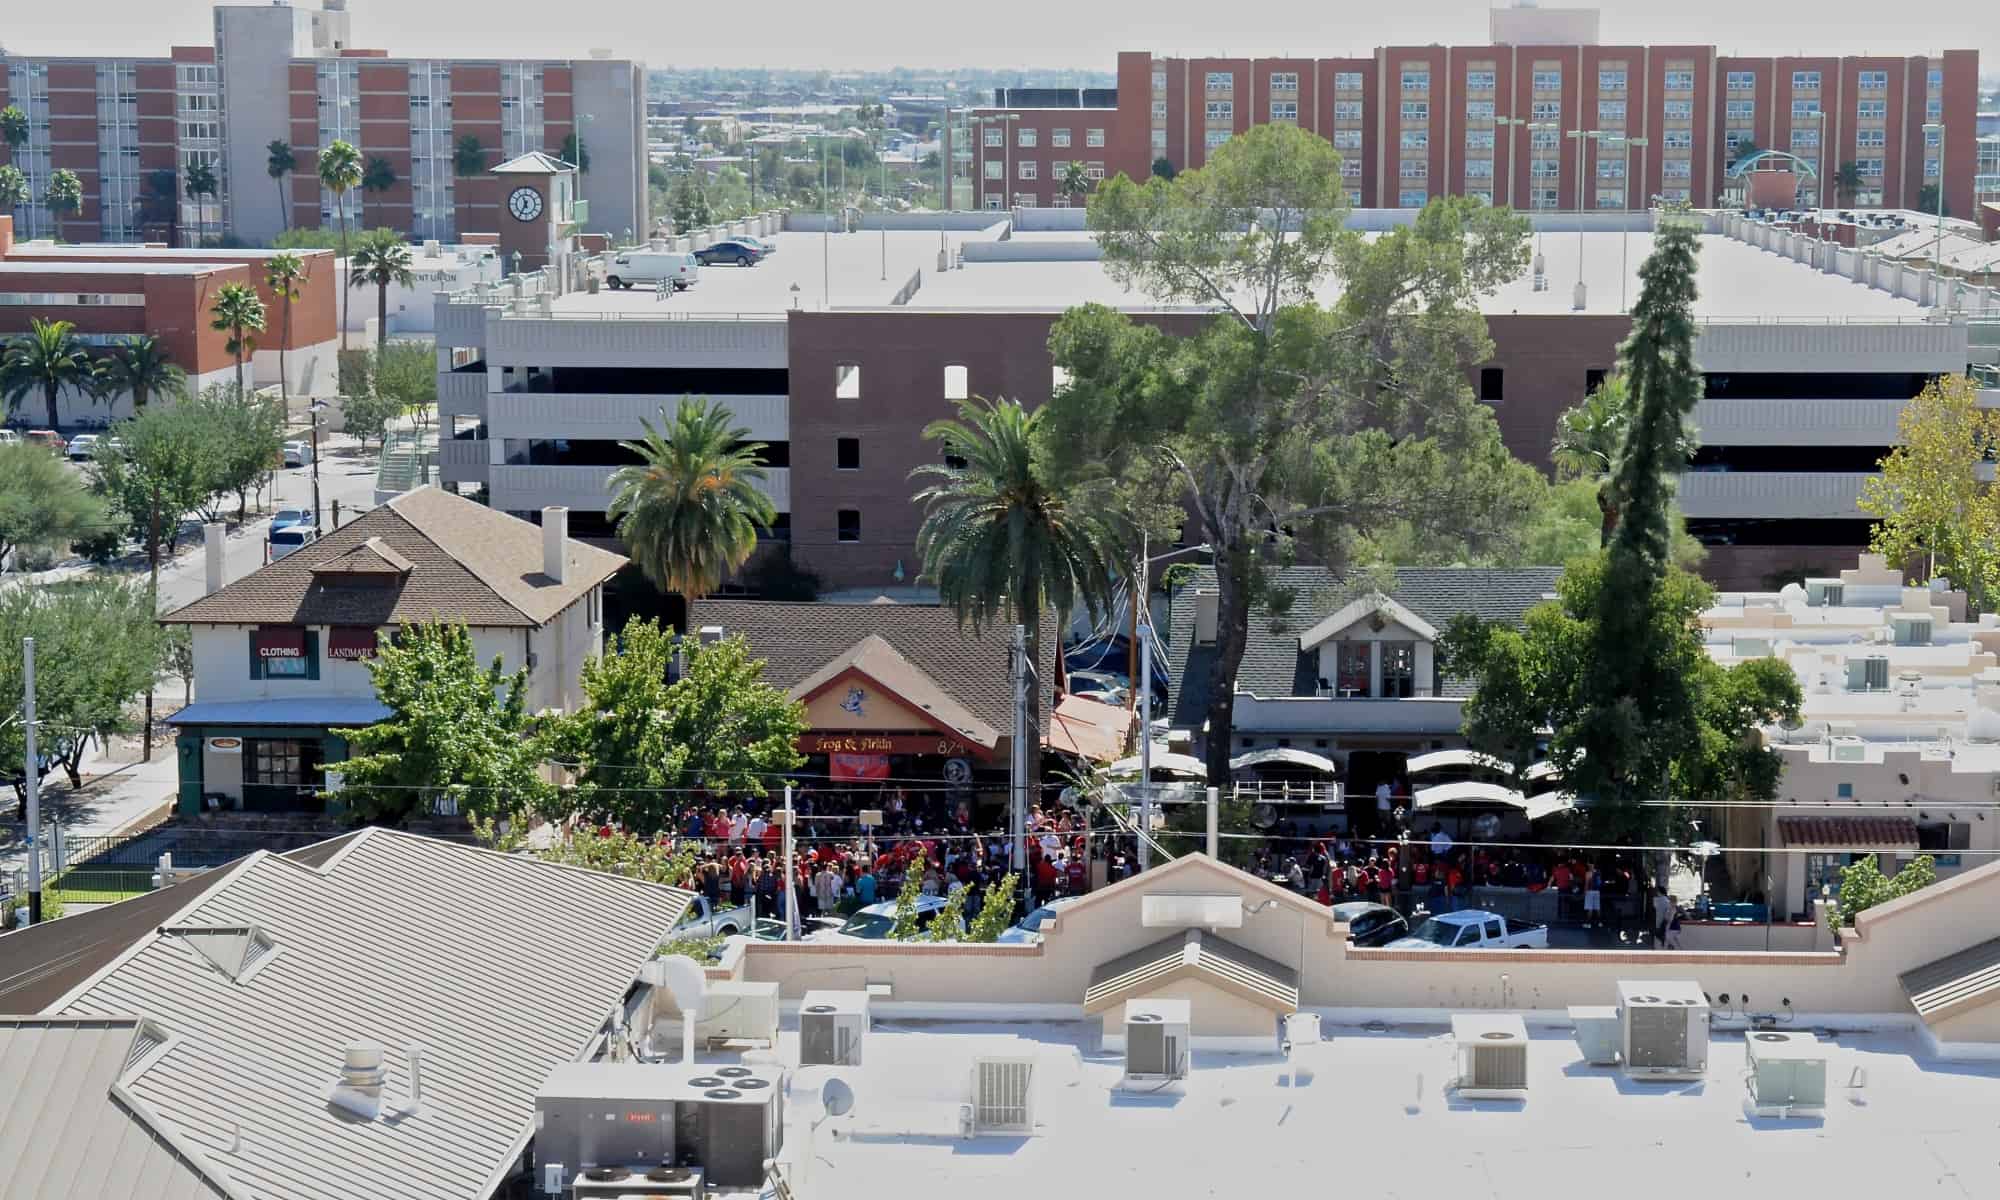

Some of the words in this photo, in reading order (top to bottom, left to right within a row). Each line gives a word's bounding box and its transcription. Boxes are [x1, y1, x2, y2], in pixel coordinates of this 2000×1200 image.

[431, 273, 457, 282] UNON
[260, 648, 299, 657] CLOTHING
[329, 648, 373, 658] LANDMARK
[816, 738, 842, 752] Frog
[844, 738, 857, 751] &
